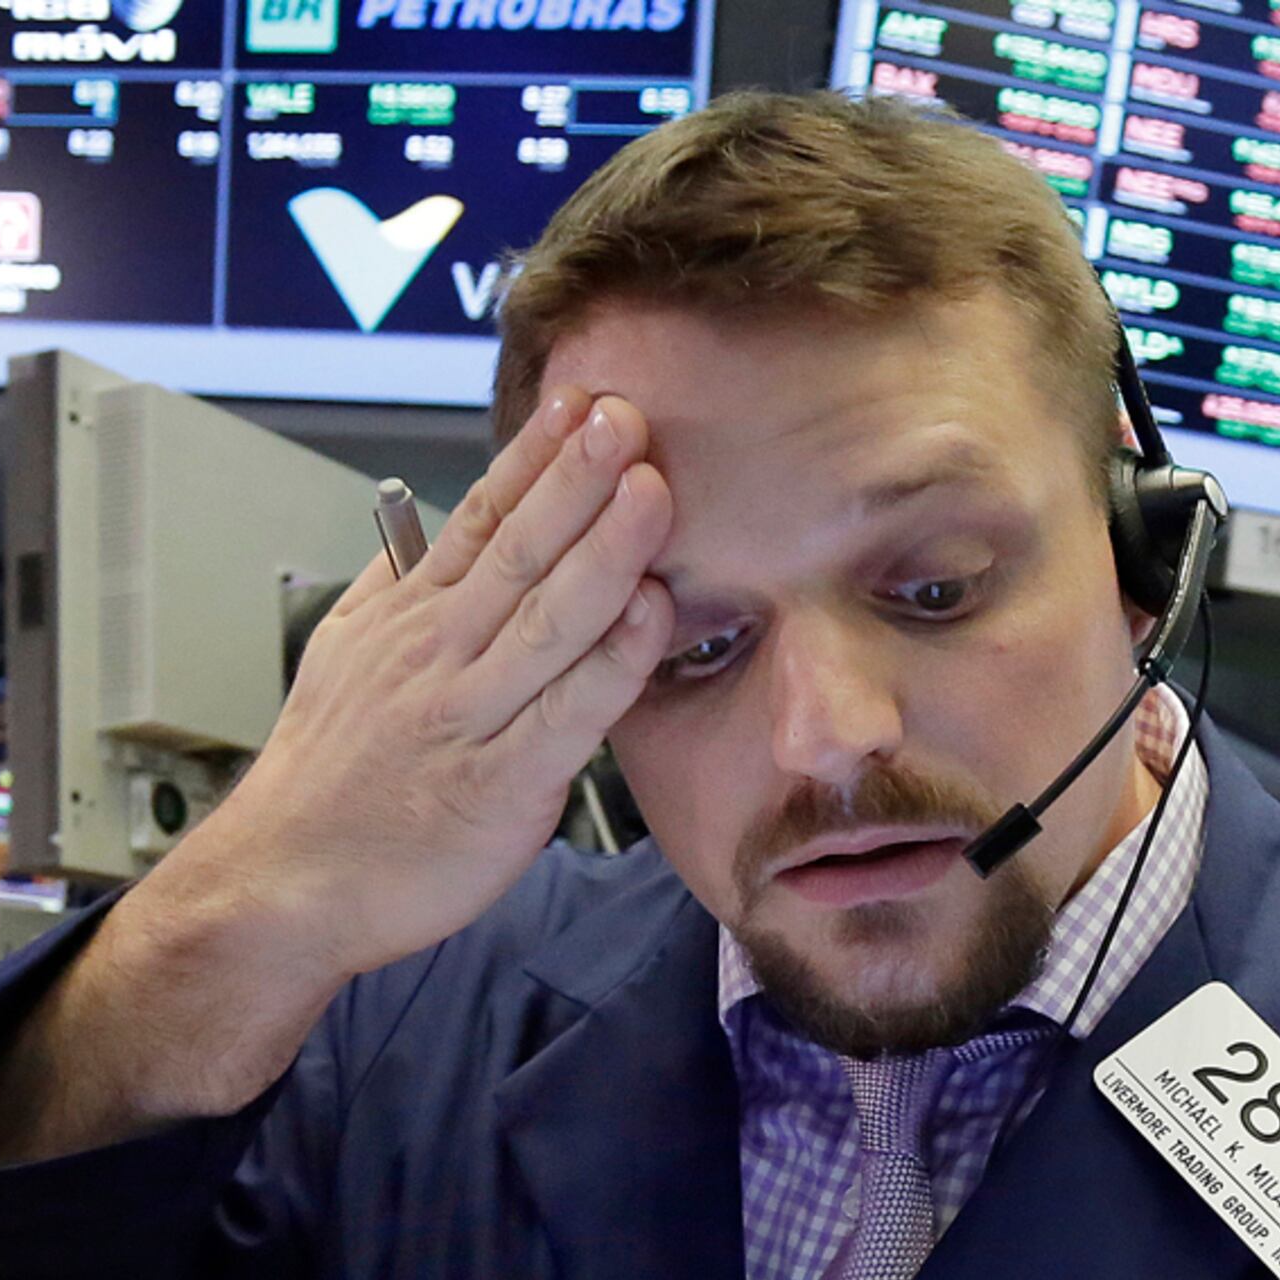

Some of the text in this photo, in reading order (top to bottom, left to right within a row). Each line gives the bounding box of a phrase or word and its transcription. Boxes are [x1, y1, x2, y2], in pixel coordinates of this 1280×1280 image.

[1100, 1070, 1172, 1142] LIVERMORE
[1167, 1138, 1224, 1196] TRADING
[1153, 1068, 1225, 1143] MICHAEL
[1223, 1139, 1246, 1164] K.
